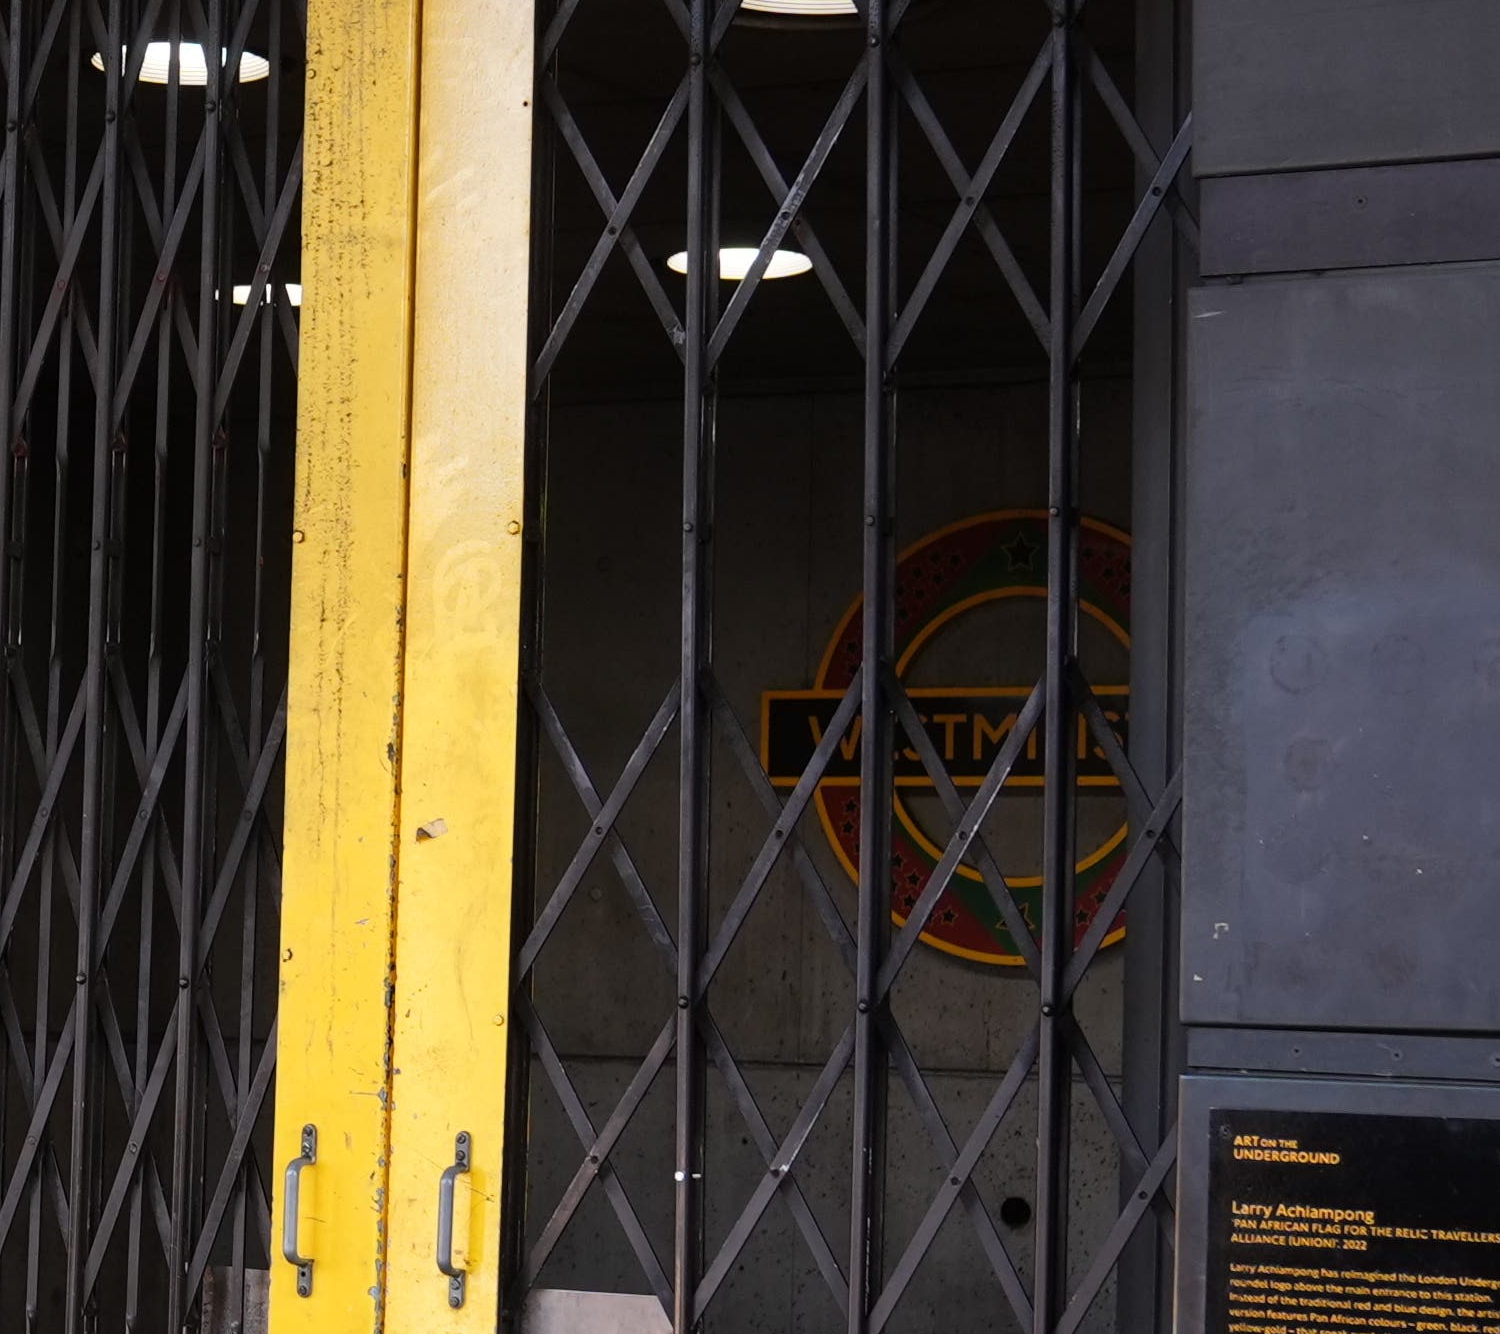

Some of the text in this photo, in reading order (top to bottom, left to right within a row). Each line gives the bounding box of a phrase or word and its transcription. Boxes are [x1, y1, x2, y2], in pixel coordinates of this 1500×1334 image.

[1233, 1135, 1298, 1149] ART ON THE
[1233, 1148, 1340, 1164] UNDERGROUND
[1231, 1201, 1273, 1219] Larry
[1258, 1220, 1309, 1232] AFRICAN
[1311, 1223, 1341, 1234] FLAG
[1343, 1225, 1368, 1235] FOR
[1369, 1226, 1393, 1237] THE
[1230, 1233, 1286, 1246] ALLIANCE
[1342, 1239, 1367, 1250] 2022
